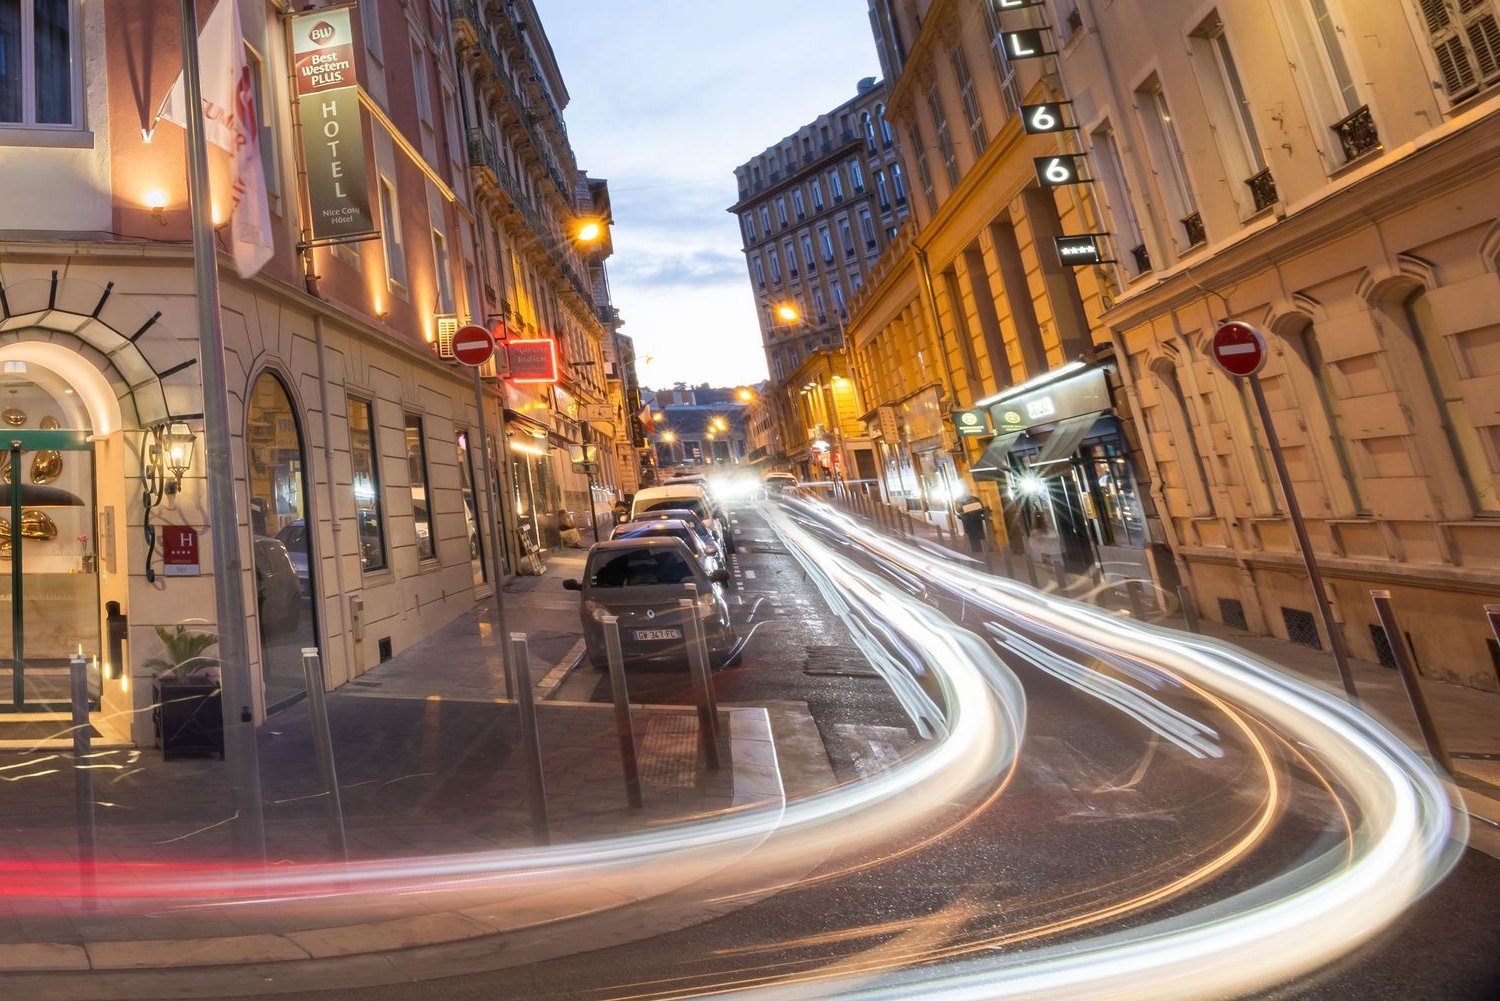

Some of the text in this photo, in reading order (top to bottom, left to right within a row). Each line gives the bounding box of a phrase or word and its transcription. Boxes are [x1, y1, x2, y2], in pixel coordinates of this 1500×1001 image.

[311, 26, 332, 40] BW
[311, 52, 338, 65] Best
[301, 60, 349, 76] Western
[322, 100, 347, 199] HOTEL
[322, 206, 360, 217] Nice Cosy
[180, 533, 193, 547] H
